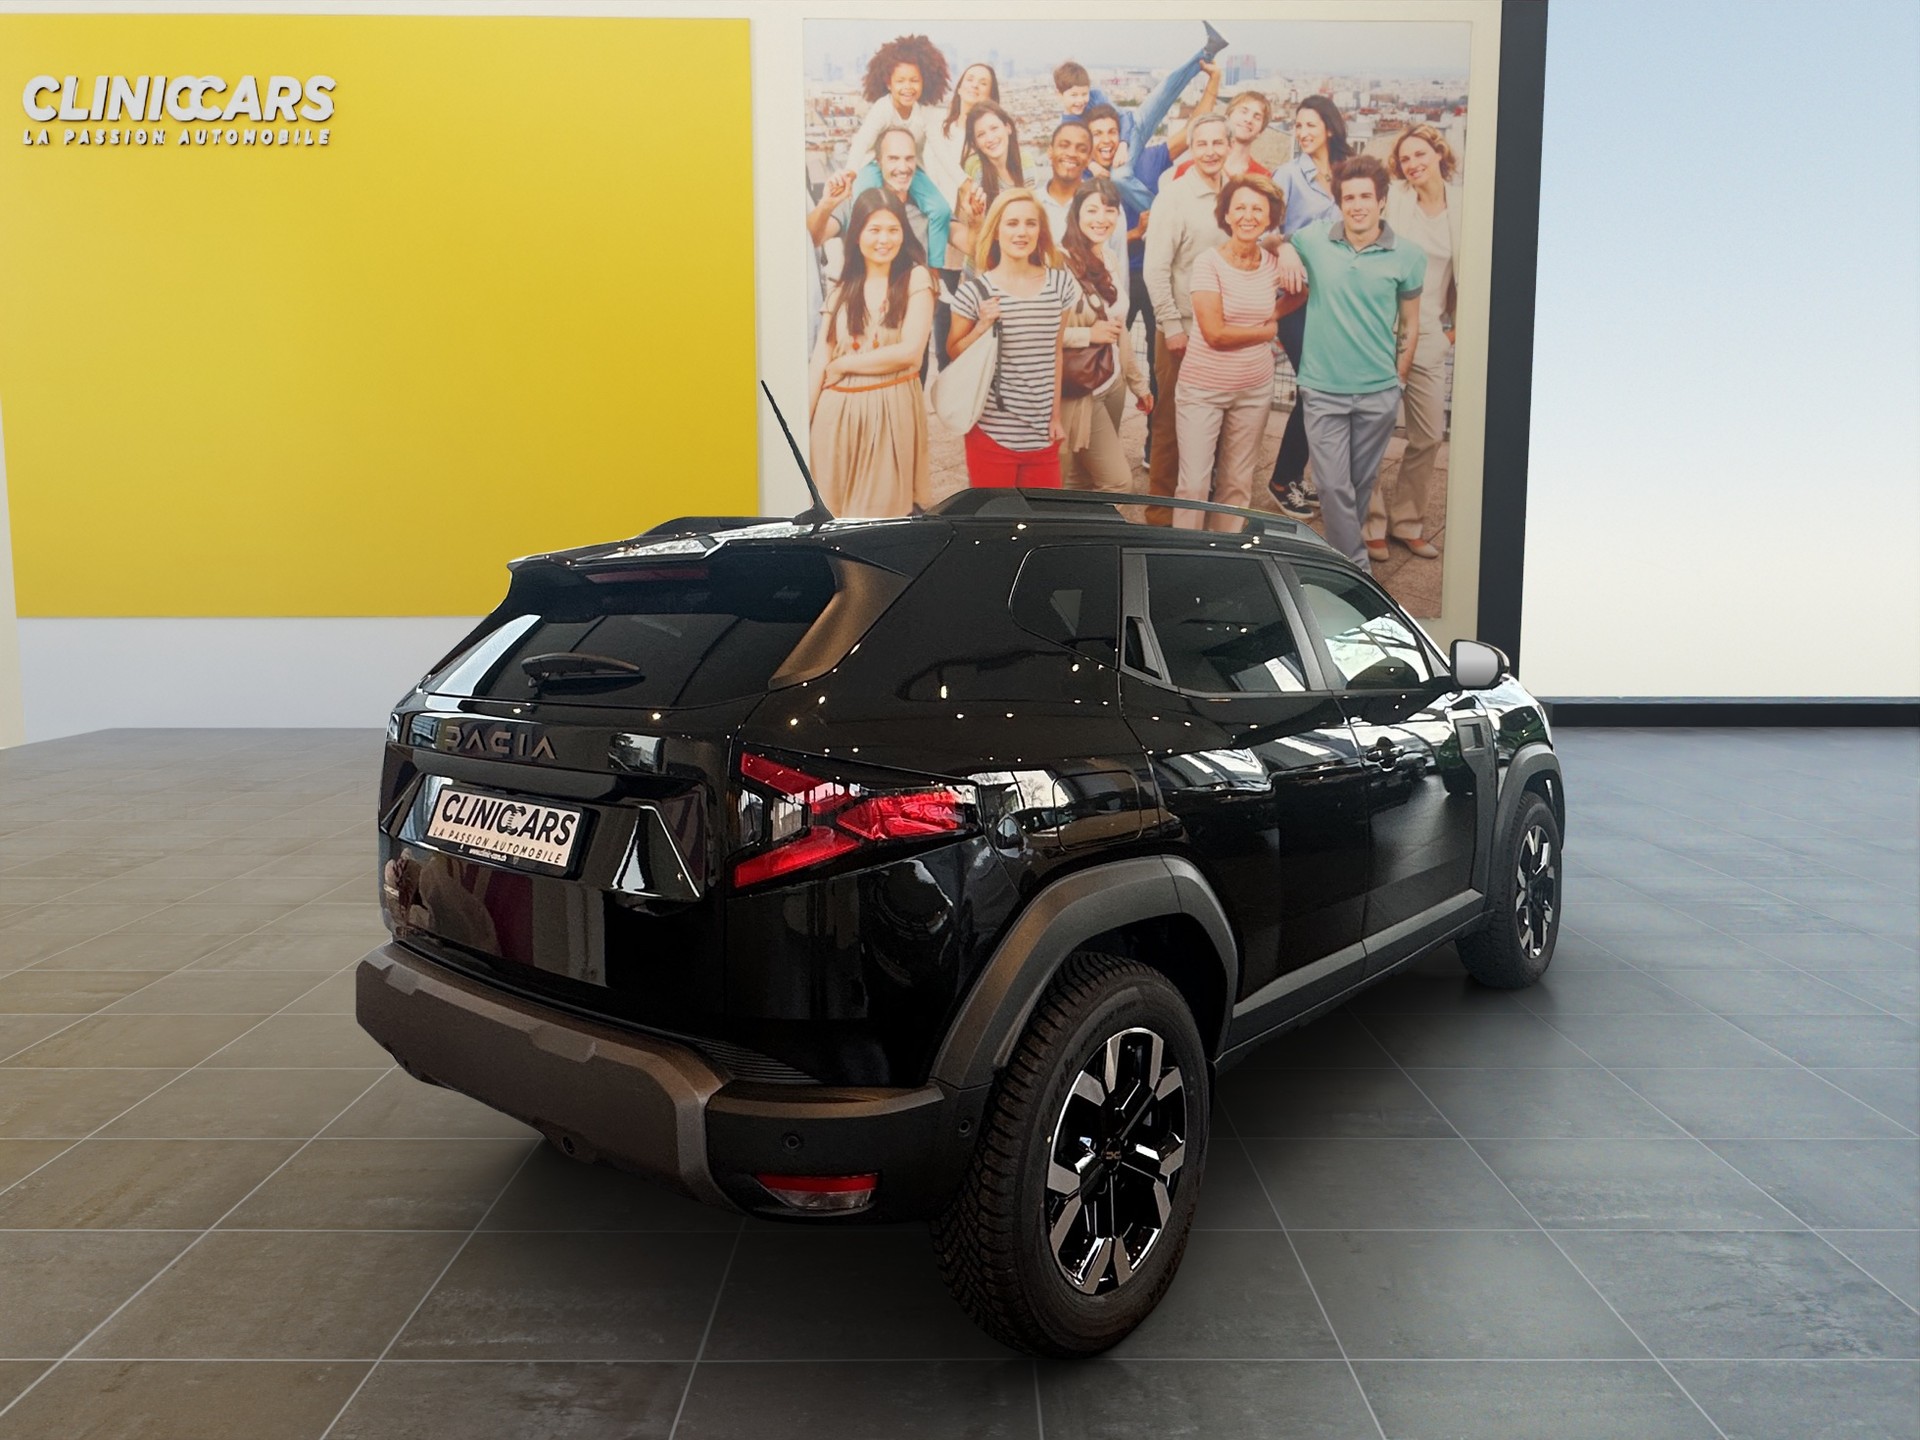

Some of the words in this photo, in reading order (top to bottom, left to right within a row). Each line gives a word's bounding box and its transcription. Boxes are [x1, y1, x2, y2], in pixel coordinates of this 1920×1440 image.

[22, 128, 50, 146] LA
[63, 128, 166, 146] PASSION
[178, 128, 331, 146] AUTOMOBILE
[432, 826, 444, 838] LA
[448, 831, 490, 847] PASSION
[492, 842, 563, 864] AUTOMOBILE
